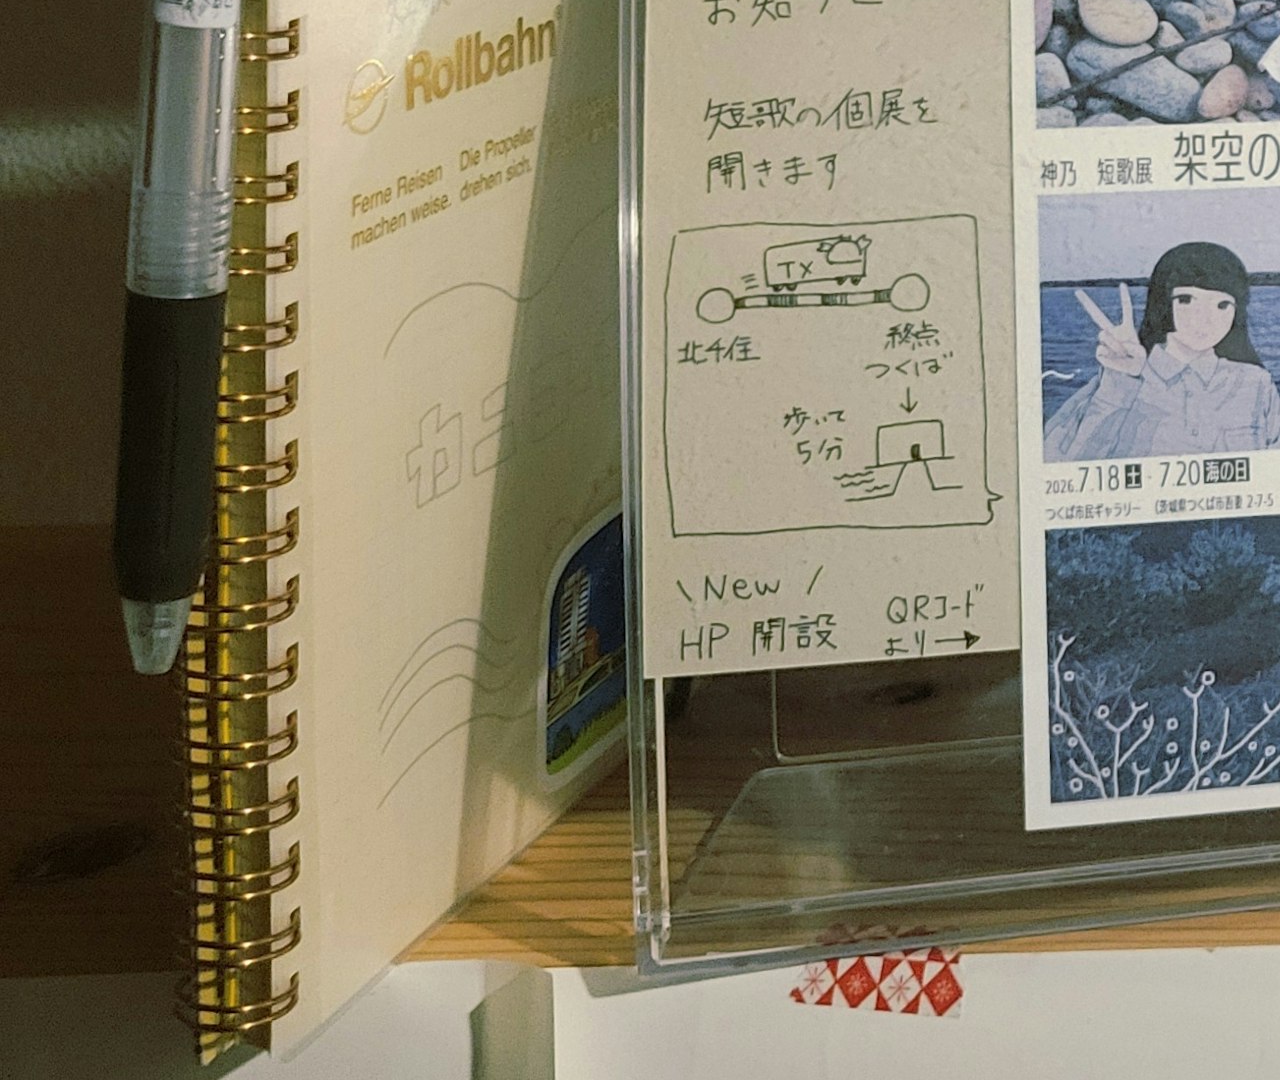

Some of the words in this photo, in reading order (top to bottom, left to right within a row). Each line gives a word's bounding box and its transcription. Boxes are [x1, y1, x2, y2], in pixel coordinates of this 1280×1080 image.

[405, 16, 558, 111] Rollbahn
[703, 88, 940, 141] 短歌の個展を
[459, 148, 482, 172] Die
[485, 123, 538, 159] Propeller
[459, 170, 503, 202] drehen
[706, 151, 838, 194] 開きます
[1039, 159, 1078, 189] 神乃
[1096, 156, 1154, 187] 短歌展
[351, 187, 392, 218] Ferne
[396, 165, 444, 200] Reisen
[351, 209, 407, 251] machen
[777, 261, 814, 280] TX
[677, 335, 761, 365] 北千住
[884, 320, 941, 351] 終点
[865, 350, 954, 379] つくば
[783, 406, 846, 435] 歩いて
[796, 437, 844, 465] 5分
[1202, 457, 1251, 484] 海の日
[1045, 500, 1141, 521] つくば市民ギャラリー
[703, 574, 781, 601] New
[886, 583, 985, 624] QRコード
[680, 622, 730, 662] HP
[752, 613, 838, 657] 開設
[884, 629, 927, 657] より
